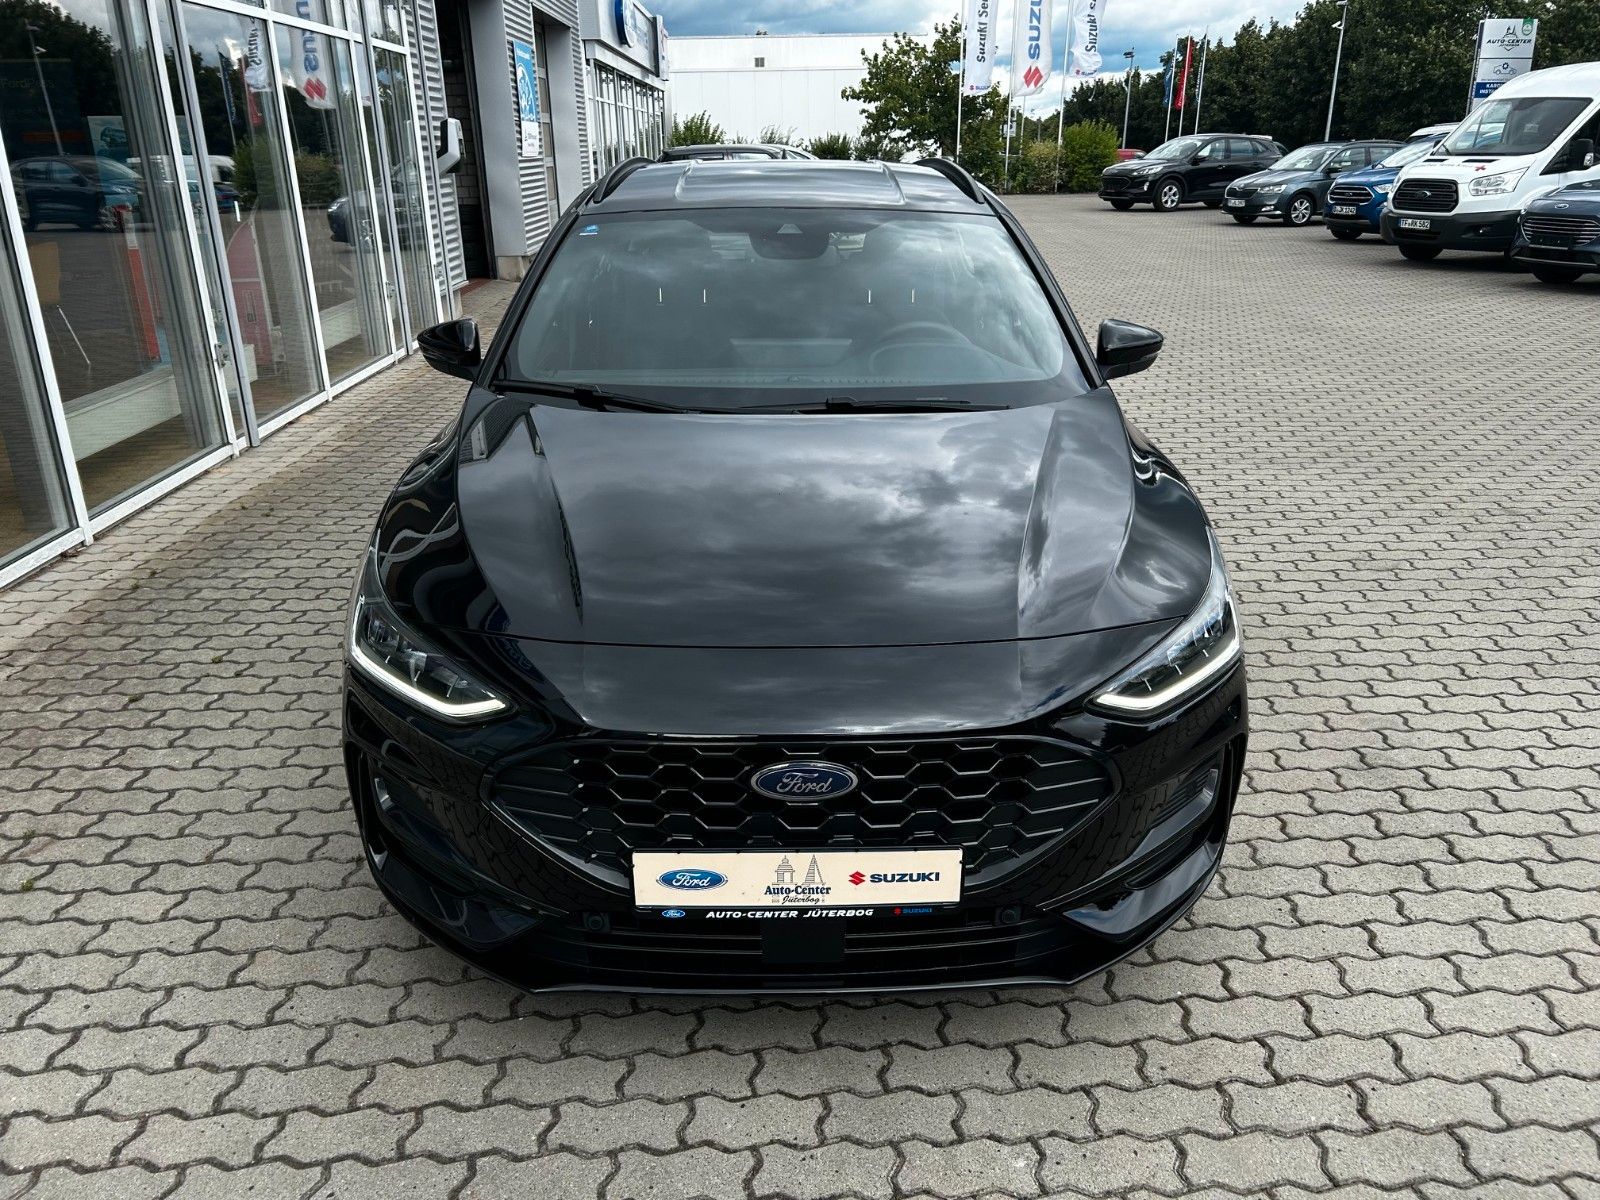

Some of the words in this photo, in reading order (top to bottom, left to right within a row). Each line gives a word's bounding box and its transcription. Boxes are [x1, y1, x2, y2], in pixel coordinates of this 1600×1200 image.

[1085, 14, 1098, 53] Suzuki
[976, 22, 988, 63] Suzuki
[776, 771, 833, 793] Ford
[671, 872, 711, 887] Ford
[869, 871, 940, 884] SUZUKI
[764, 885, 832, 896] Auto-Center
[781, 895, 821, 905] Jüterbog
[705, 910, 799, 919] AUTO-CENTER
[802, 908, 874, 918] JÜTERBOG
